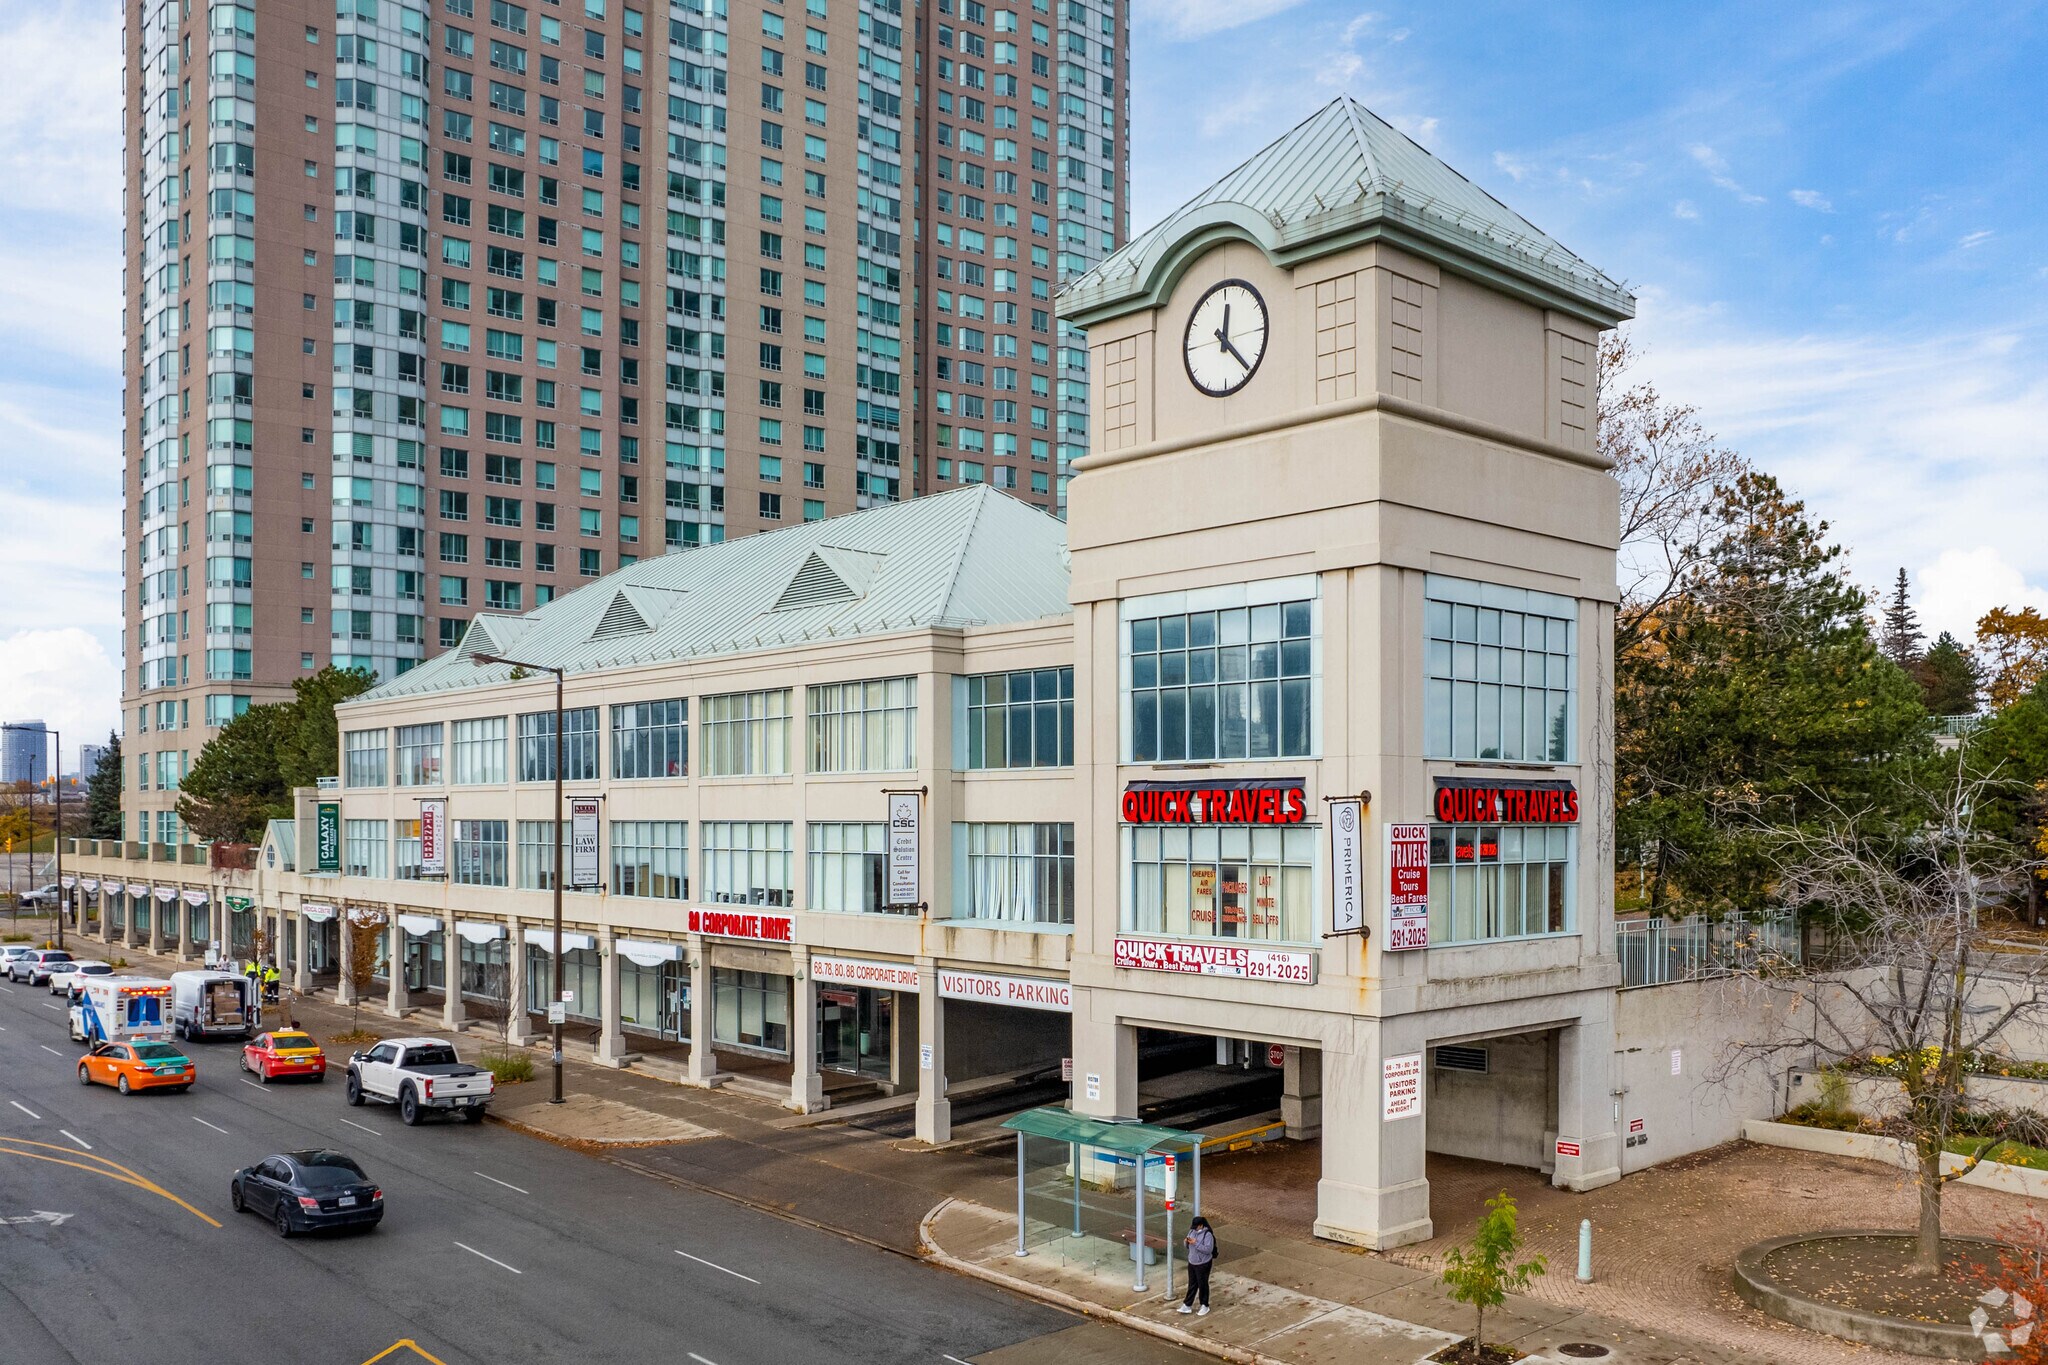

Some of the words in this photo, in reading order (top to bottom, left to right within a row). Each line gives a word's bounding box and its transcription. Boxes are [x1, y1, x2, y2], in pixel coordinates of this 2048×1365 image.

[1122, 790, 1192, 824] QUICK
[1197, 787, 1305, 824] TRAVELS
[1437, 788, 1499, 822] QUICK
[1504, 789, 1578, 822] TRAVELS
[321, 816, 329, 859] GALAXY
[424, 812, 433, 858] STANDARD
[1393, 826, 1426, 839] QUICK
[1392, 843, 1427, 867] TRAVELS
[1259, 876, 1271, 886] LAST
[1344, 837, 1353, 923] PRIMERICA
[1398, 870, 1420, 879] Cruise
[1400, 881, 1419, 891] Tours
[1257, 898, 1274, 907] MINUTE
[1392, 894, 1407, 904] Best
[1408, 893, 1427, 903] Fares
[1192, 910, 1216, 923] CRUISE
[1252, 914, 1264, 924] SELL
[1266, 915, 1278, 925] OFFS
[689, 910, 700, 931] 80
[702, 912, 758, 937] CORPORATE
[761, 916, 790, 940] DRIVE
[1392, 928, 1426, 947] 291-2025
[1116, 941, 1167, 960] QUICK
[1168, 945, 1248, 966] TRAVELS
[1267, 954, 1290, 963] (416)
[1116, 958, 1136, 966] Cruise
[1141, 959, 1158, 968] Tours
[1164, 961, 1179, 970] Best
[1180, 963, 1198, 972] Fares
[1250, 962, 1308, 980] 291-2025
[856, 966, 896, 983] CORPORATE
[898, 970, 918, 985] DRIVE
[943, 976, 1001, 996] VISITORS
[1008, 983, 1069, 1005] PARKING
[1270, 1050, 1283, 1059] STOP
[1385, 1069, 1411, 1079] CORPORATE
[1389, 1079, 1416, 1089] VISITORS
[1390, 1087, 1416, 1097] PARKING
